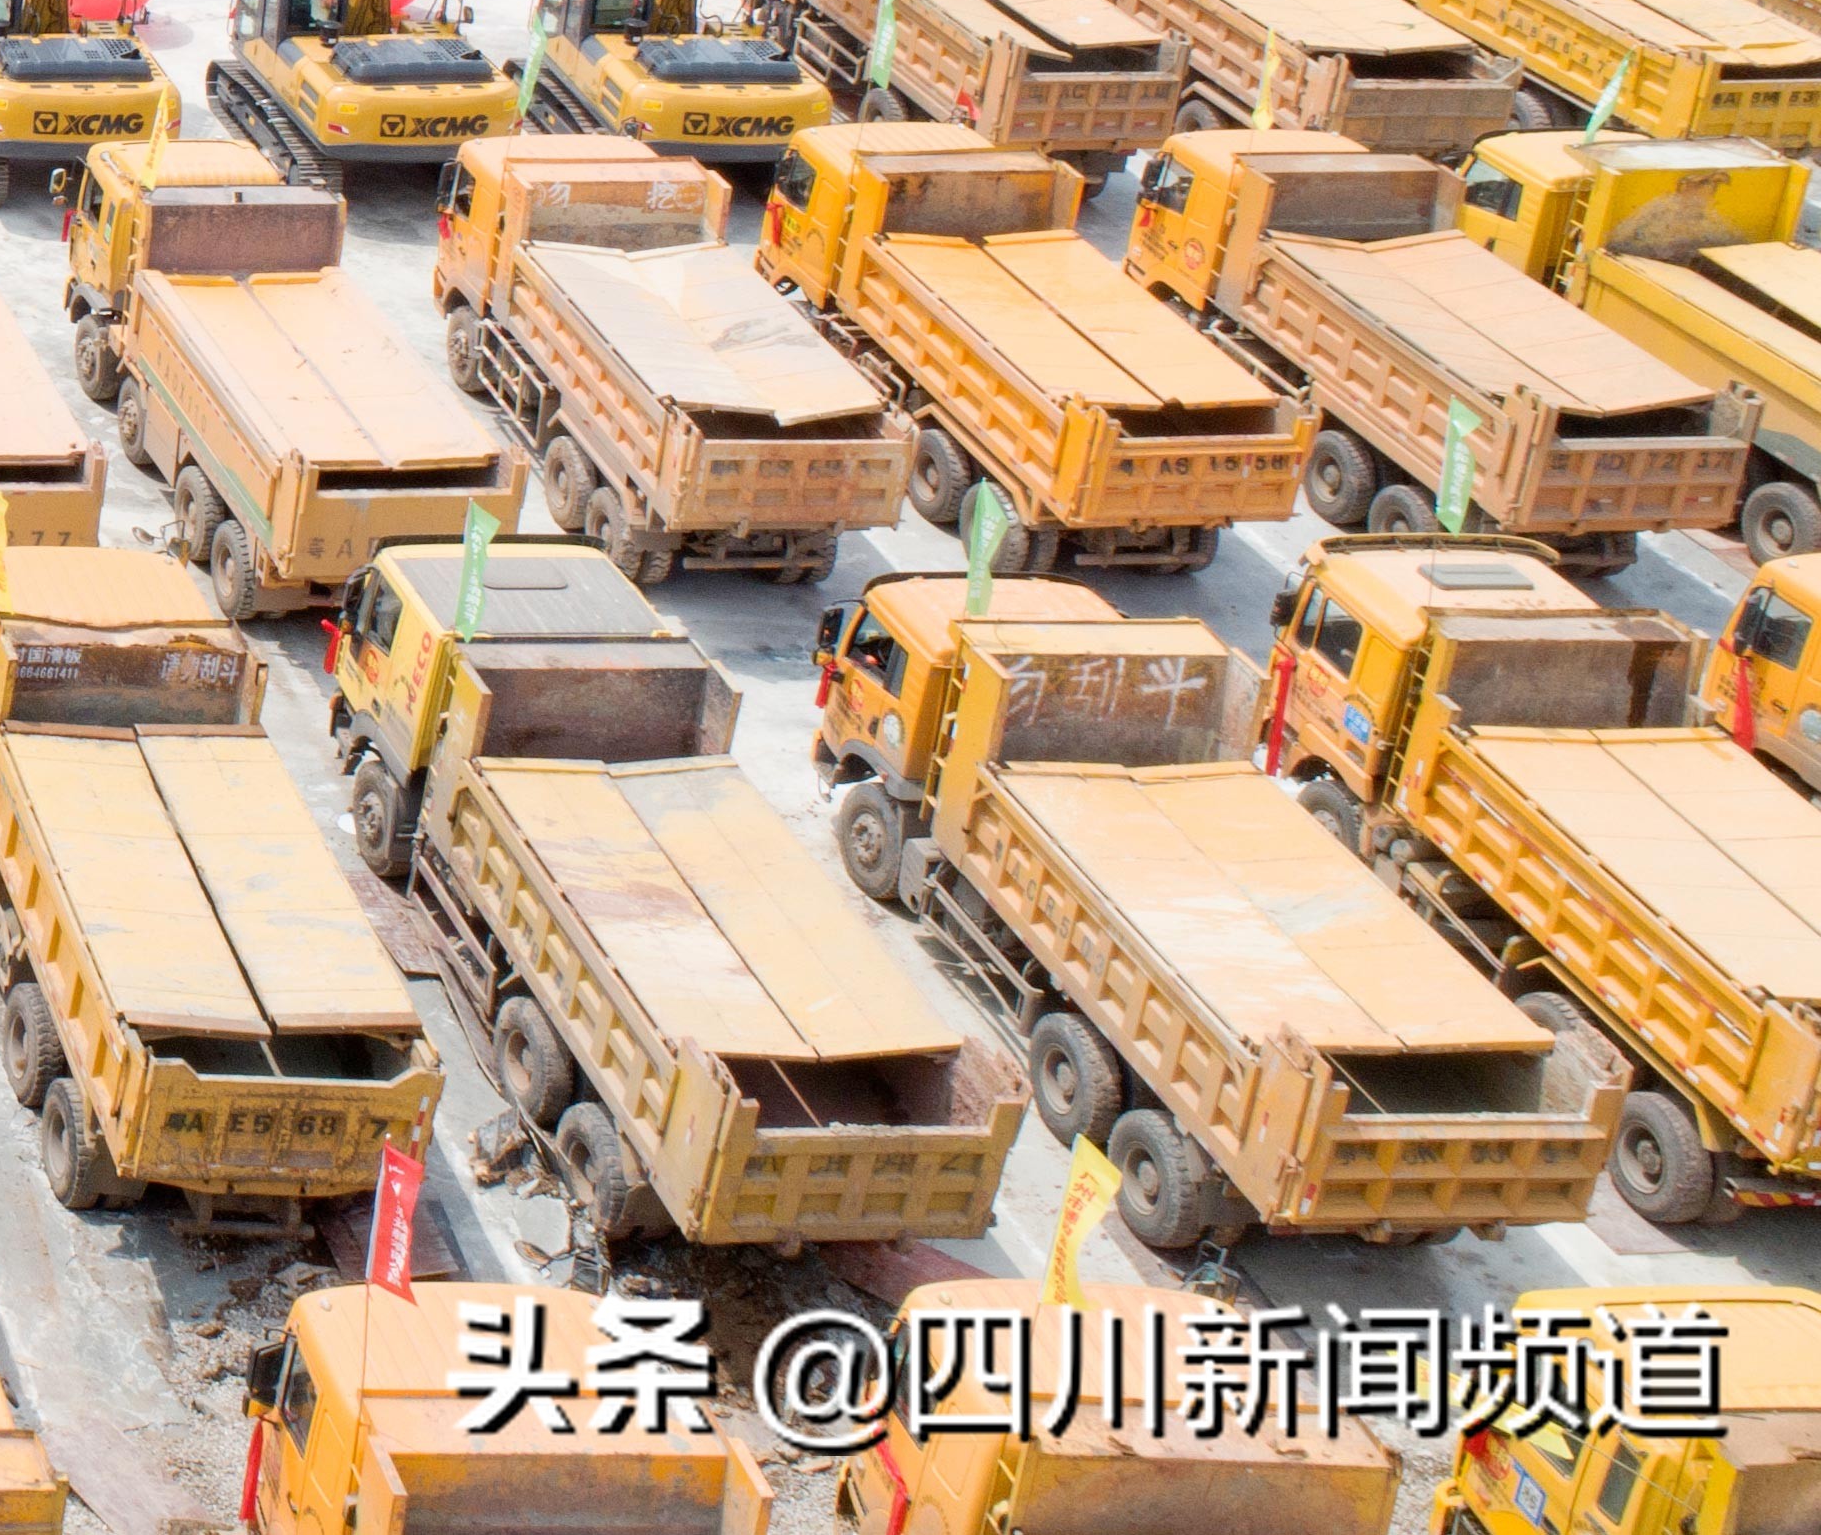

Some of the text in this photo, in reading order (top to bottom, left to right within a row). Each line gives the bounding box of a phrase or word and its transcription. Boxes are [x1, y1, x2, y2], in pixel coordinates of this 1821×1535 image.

[63, 112, 144, 135] XCMG
[411, 114, 489, 137] XCMG
[714, 114, 795, 136] XCMG
